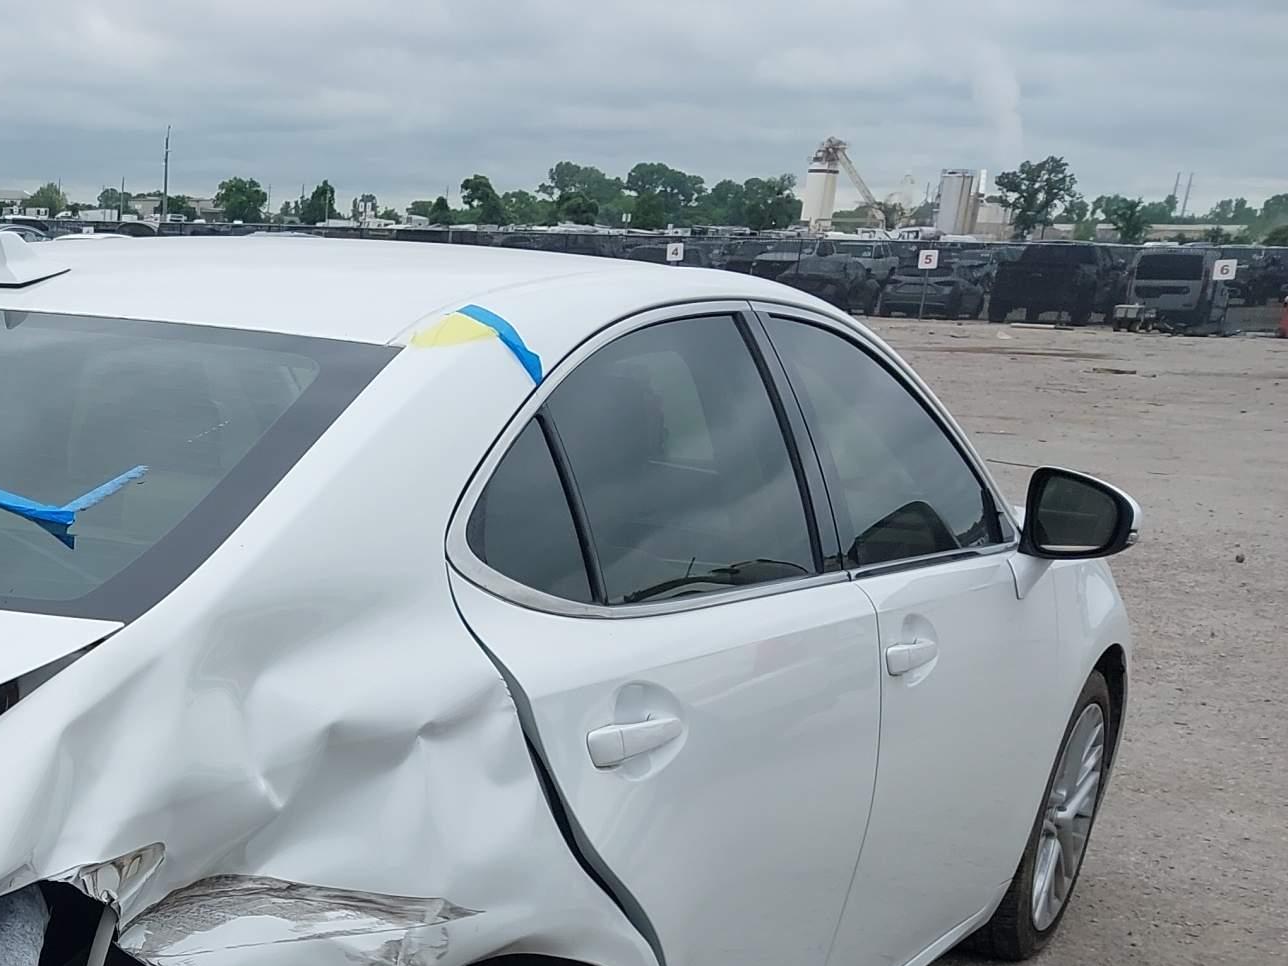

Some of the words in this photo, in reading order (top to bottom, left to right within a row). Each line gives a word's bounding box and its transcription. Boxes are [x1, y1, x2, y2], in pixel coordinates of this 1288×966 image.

[671, 247, 679, 257] 4
[924, 254, 933, 265] 5
[1220, 264, 1230, 275] 6
